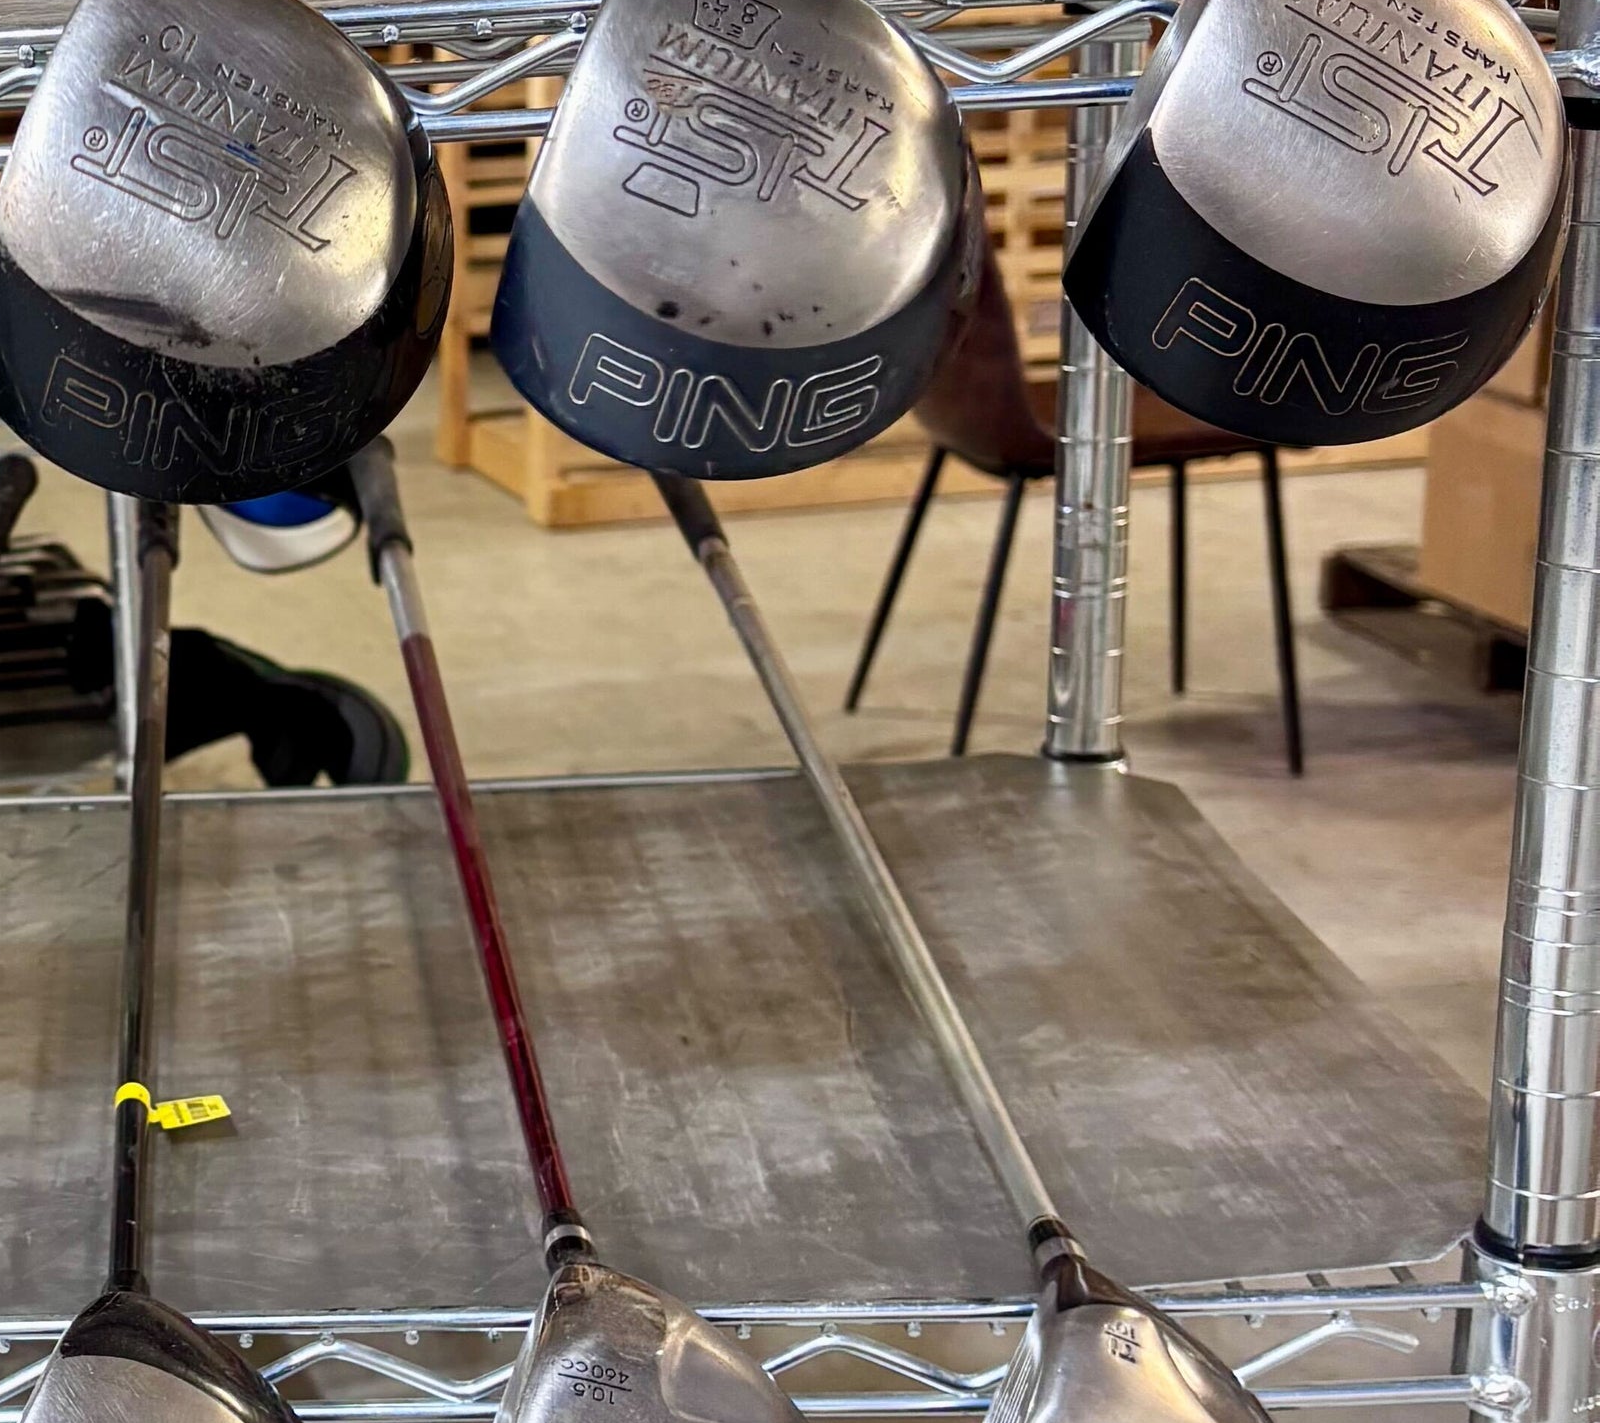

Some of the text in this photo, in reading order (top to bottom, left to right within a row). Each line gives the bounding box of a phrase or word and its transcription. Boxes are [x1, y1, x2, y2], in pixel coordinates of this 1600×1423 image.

[216, 62, 338, 143] KARSTEN
[569, 332, 883, 453] PING
[1151, 277, 1470, 416] PING
[41, 354, 343, 476] PING
[572, 1381, 616, 1405] 10.5
